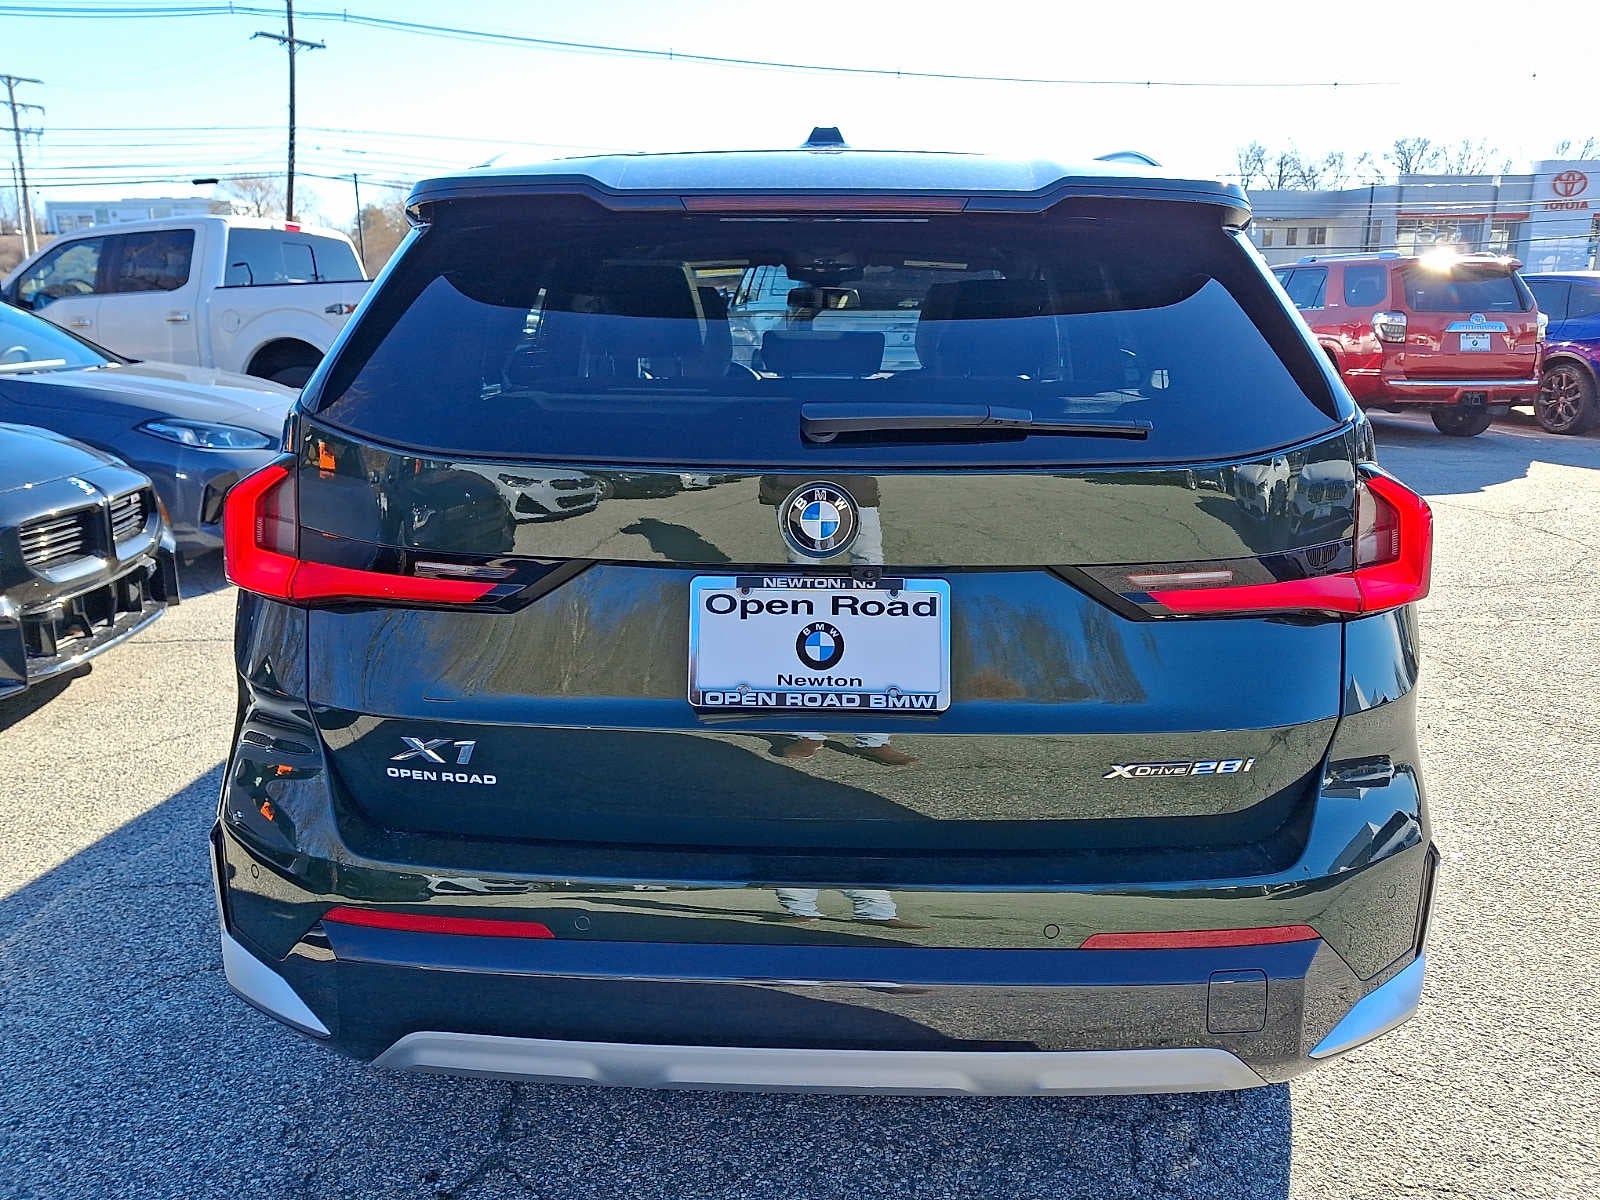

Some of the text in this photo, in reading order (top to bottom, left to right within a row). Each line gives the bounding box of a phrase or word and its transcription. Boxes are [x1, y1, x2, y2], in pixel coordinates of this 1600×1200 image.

[1544, 199, 1589, 210] TOYOTA
[794, 489, 847, 511] BMW
[763, 577, 876, 590] NEWTON, NJ
[705, 593, 937, 619] Open Road
[803, 623, 839, 638] BMW
[777, 674, 863, 687] Newton
[705, 691, 934, 709] OPEN ROAD BMW
[389, 736, 477, 765] X1
[386, 767, 497, 785] OPEN ROAD
